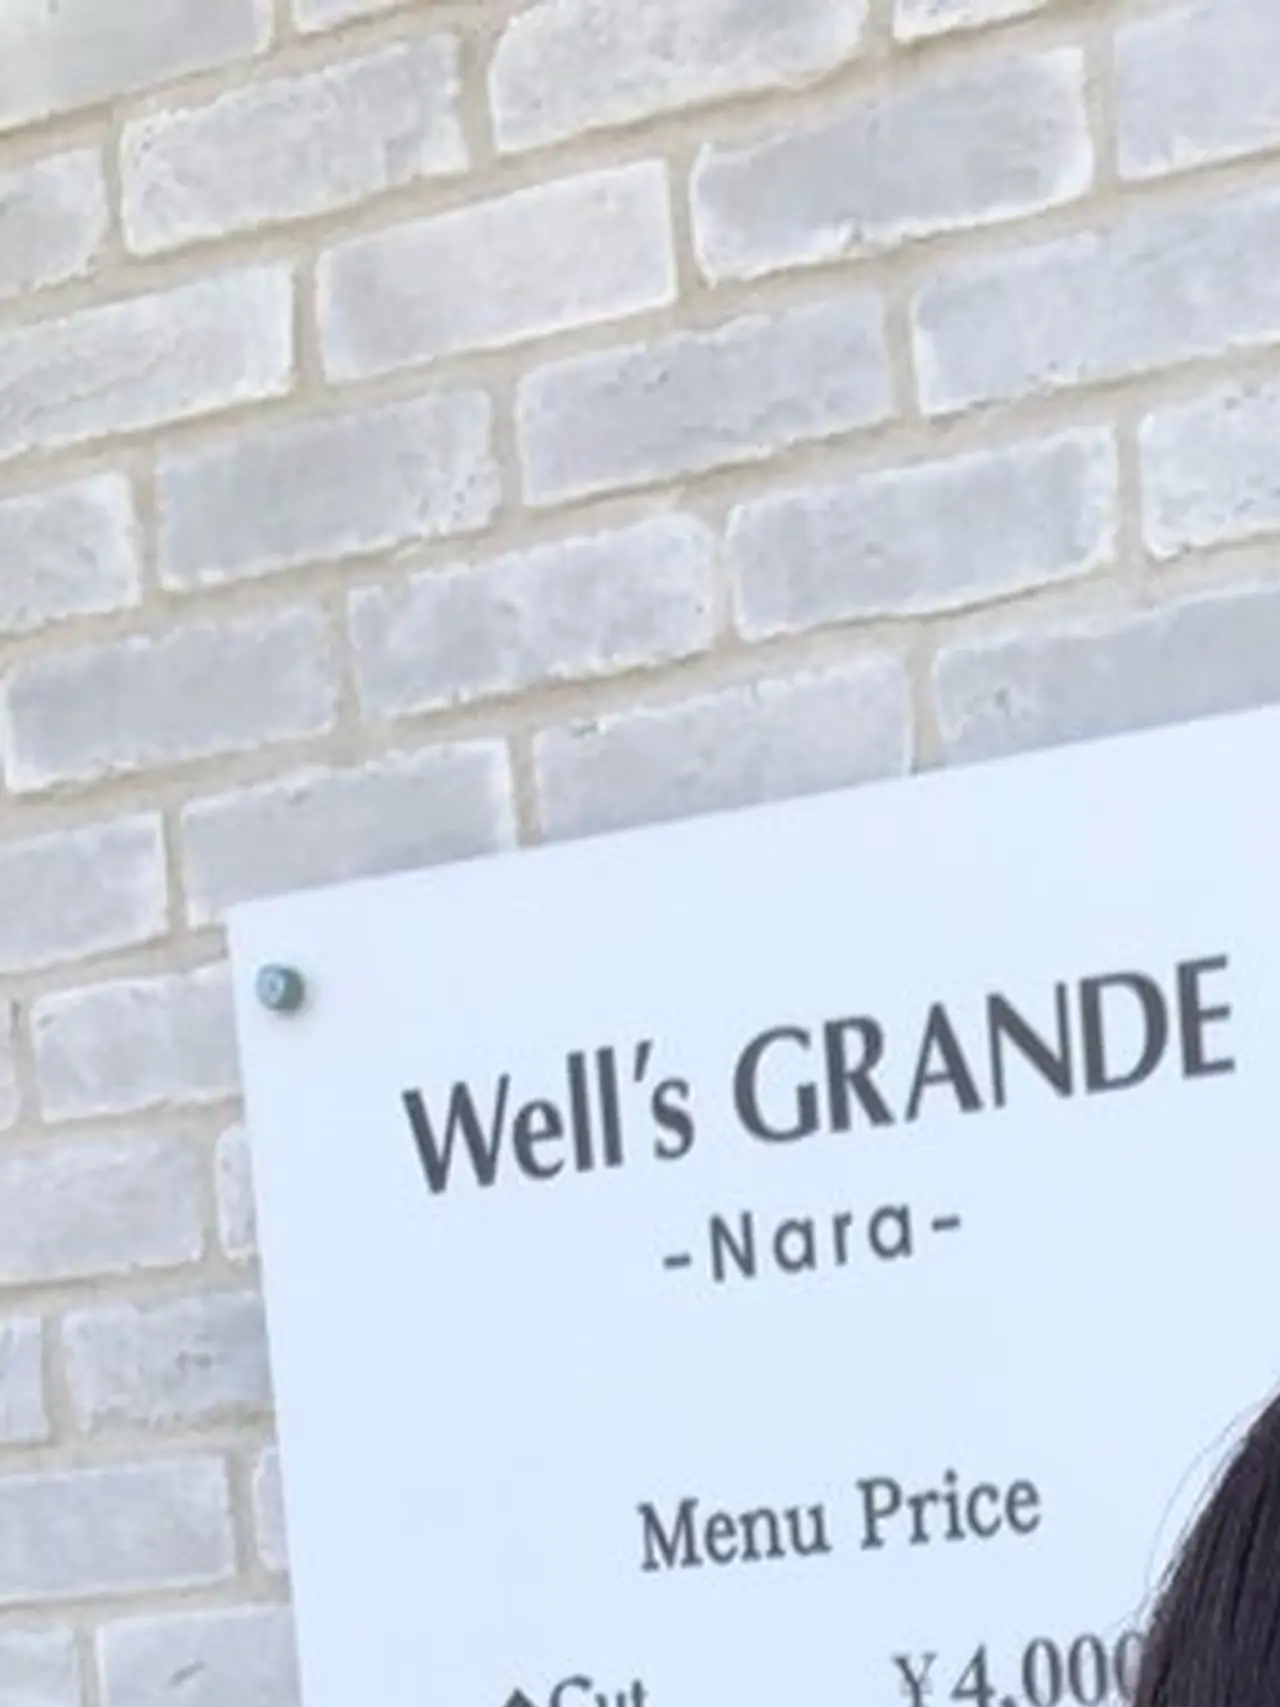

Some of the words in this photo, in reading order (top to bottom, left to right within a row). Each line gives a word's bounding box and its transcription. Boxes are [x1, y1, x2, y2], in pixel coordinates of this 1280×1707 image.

[400, 1039, 695, 1196] Well's
[732, 953, 1236, 1144] GRANDE
[636, 1496, 833, 1574] Menu
[855, 1468, 1042, 1551] Price
